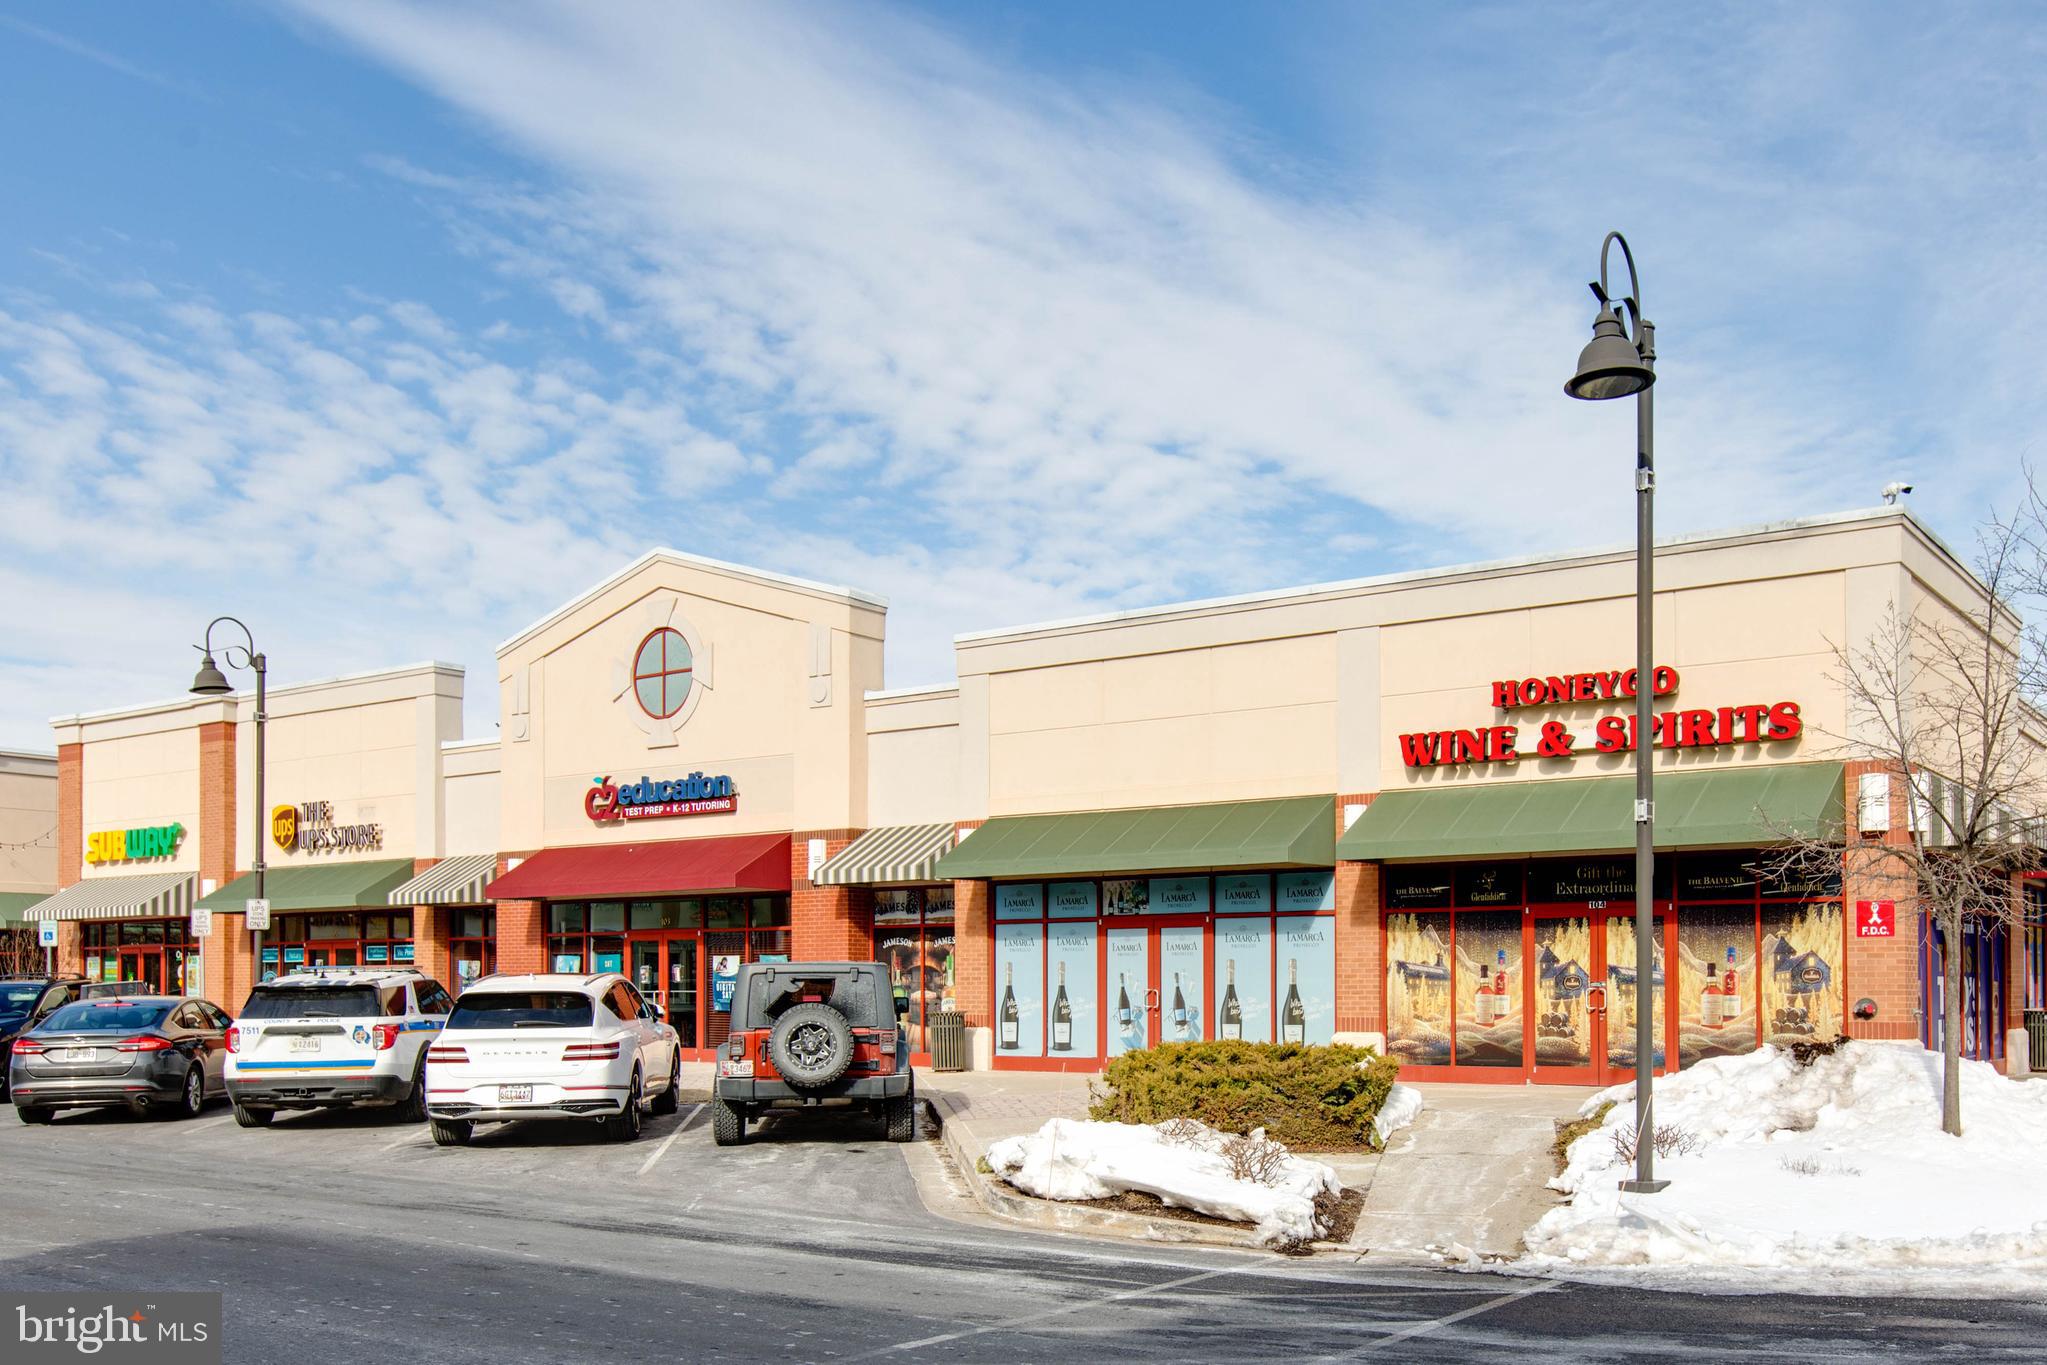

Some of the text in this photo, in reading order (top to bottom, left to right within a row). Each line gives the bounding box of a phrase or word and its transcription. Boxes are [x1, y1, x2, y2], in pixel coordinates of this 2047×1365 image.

[1399, 701, 1804, 768] WINE & SPIRITS
[617, 772, 732, 805] education
[301, 801, 330, 822] THE
[625, 799, 731, 817] TEST PREP K-12 TUTORING
[85, 822, 182, 864] SUBWAY
[299, 823, 379, 850] UPS STORE
[1862, 926, 1890, 935] F.D.C.
[882, 937, 914, 949] JAMESON
[241, 1026, 260, 1035] 7511
